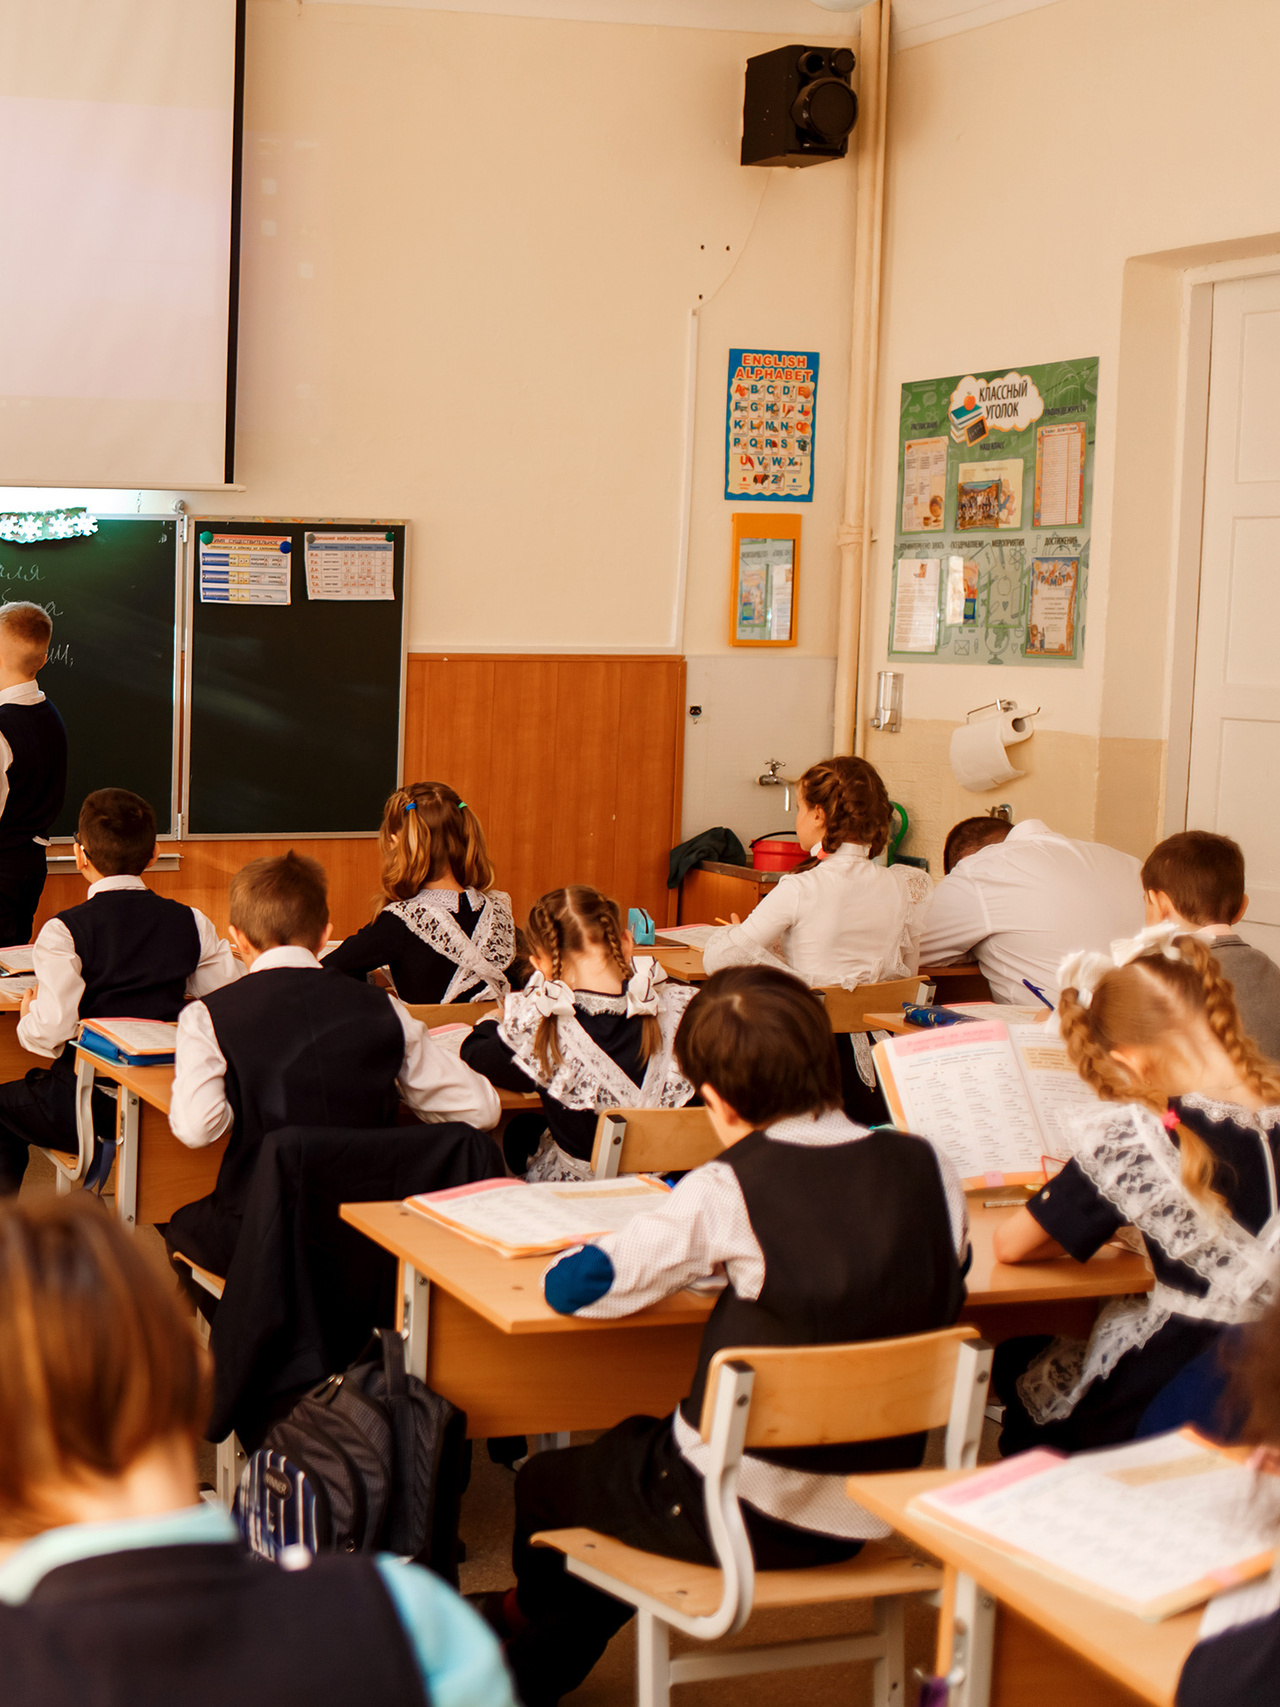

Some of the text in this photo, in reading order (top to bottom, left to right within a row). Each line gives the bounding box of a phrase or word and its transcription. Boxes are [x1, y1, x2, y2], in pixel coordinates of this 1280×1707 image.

[743, 354, 807, 368] ENGLISH
[735, 368, 813, 381] ALPHABET
[751, 384, 790, 395] B C D
[979, 380, 1029, 402] КЛАССНЫЙ
[985, 402, 1020, 420] УГОЛОК
[734, 420, 789, 431] K N
[734, 438, 788, 448] P S
[757, 456, 782, 466] V W
[1037, 571, 1073, 586] ГРАМОТА
